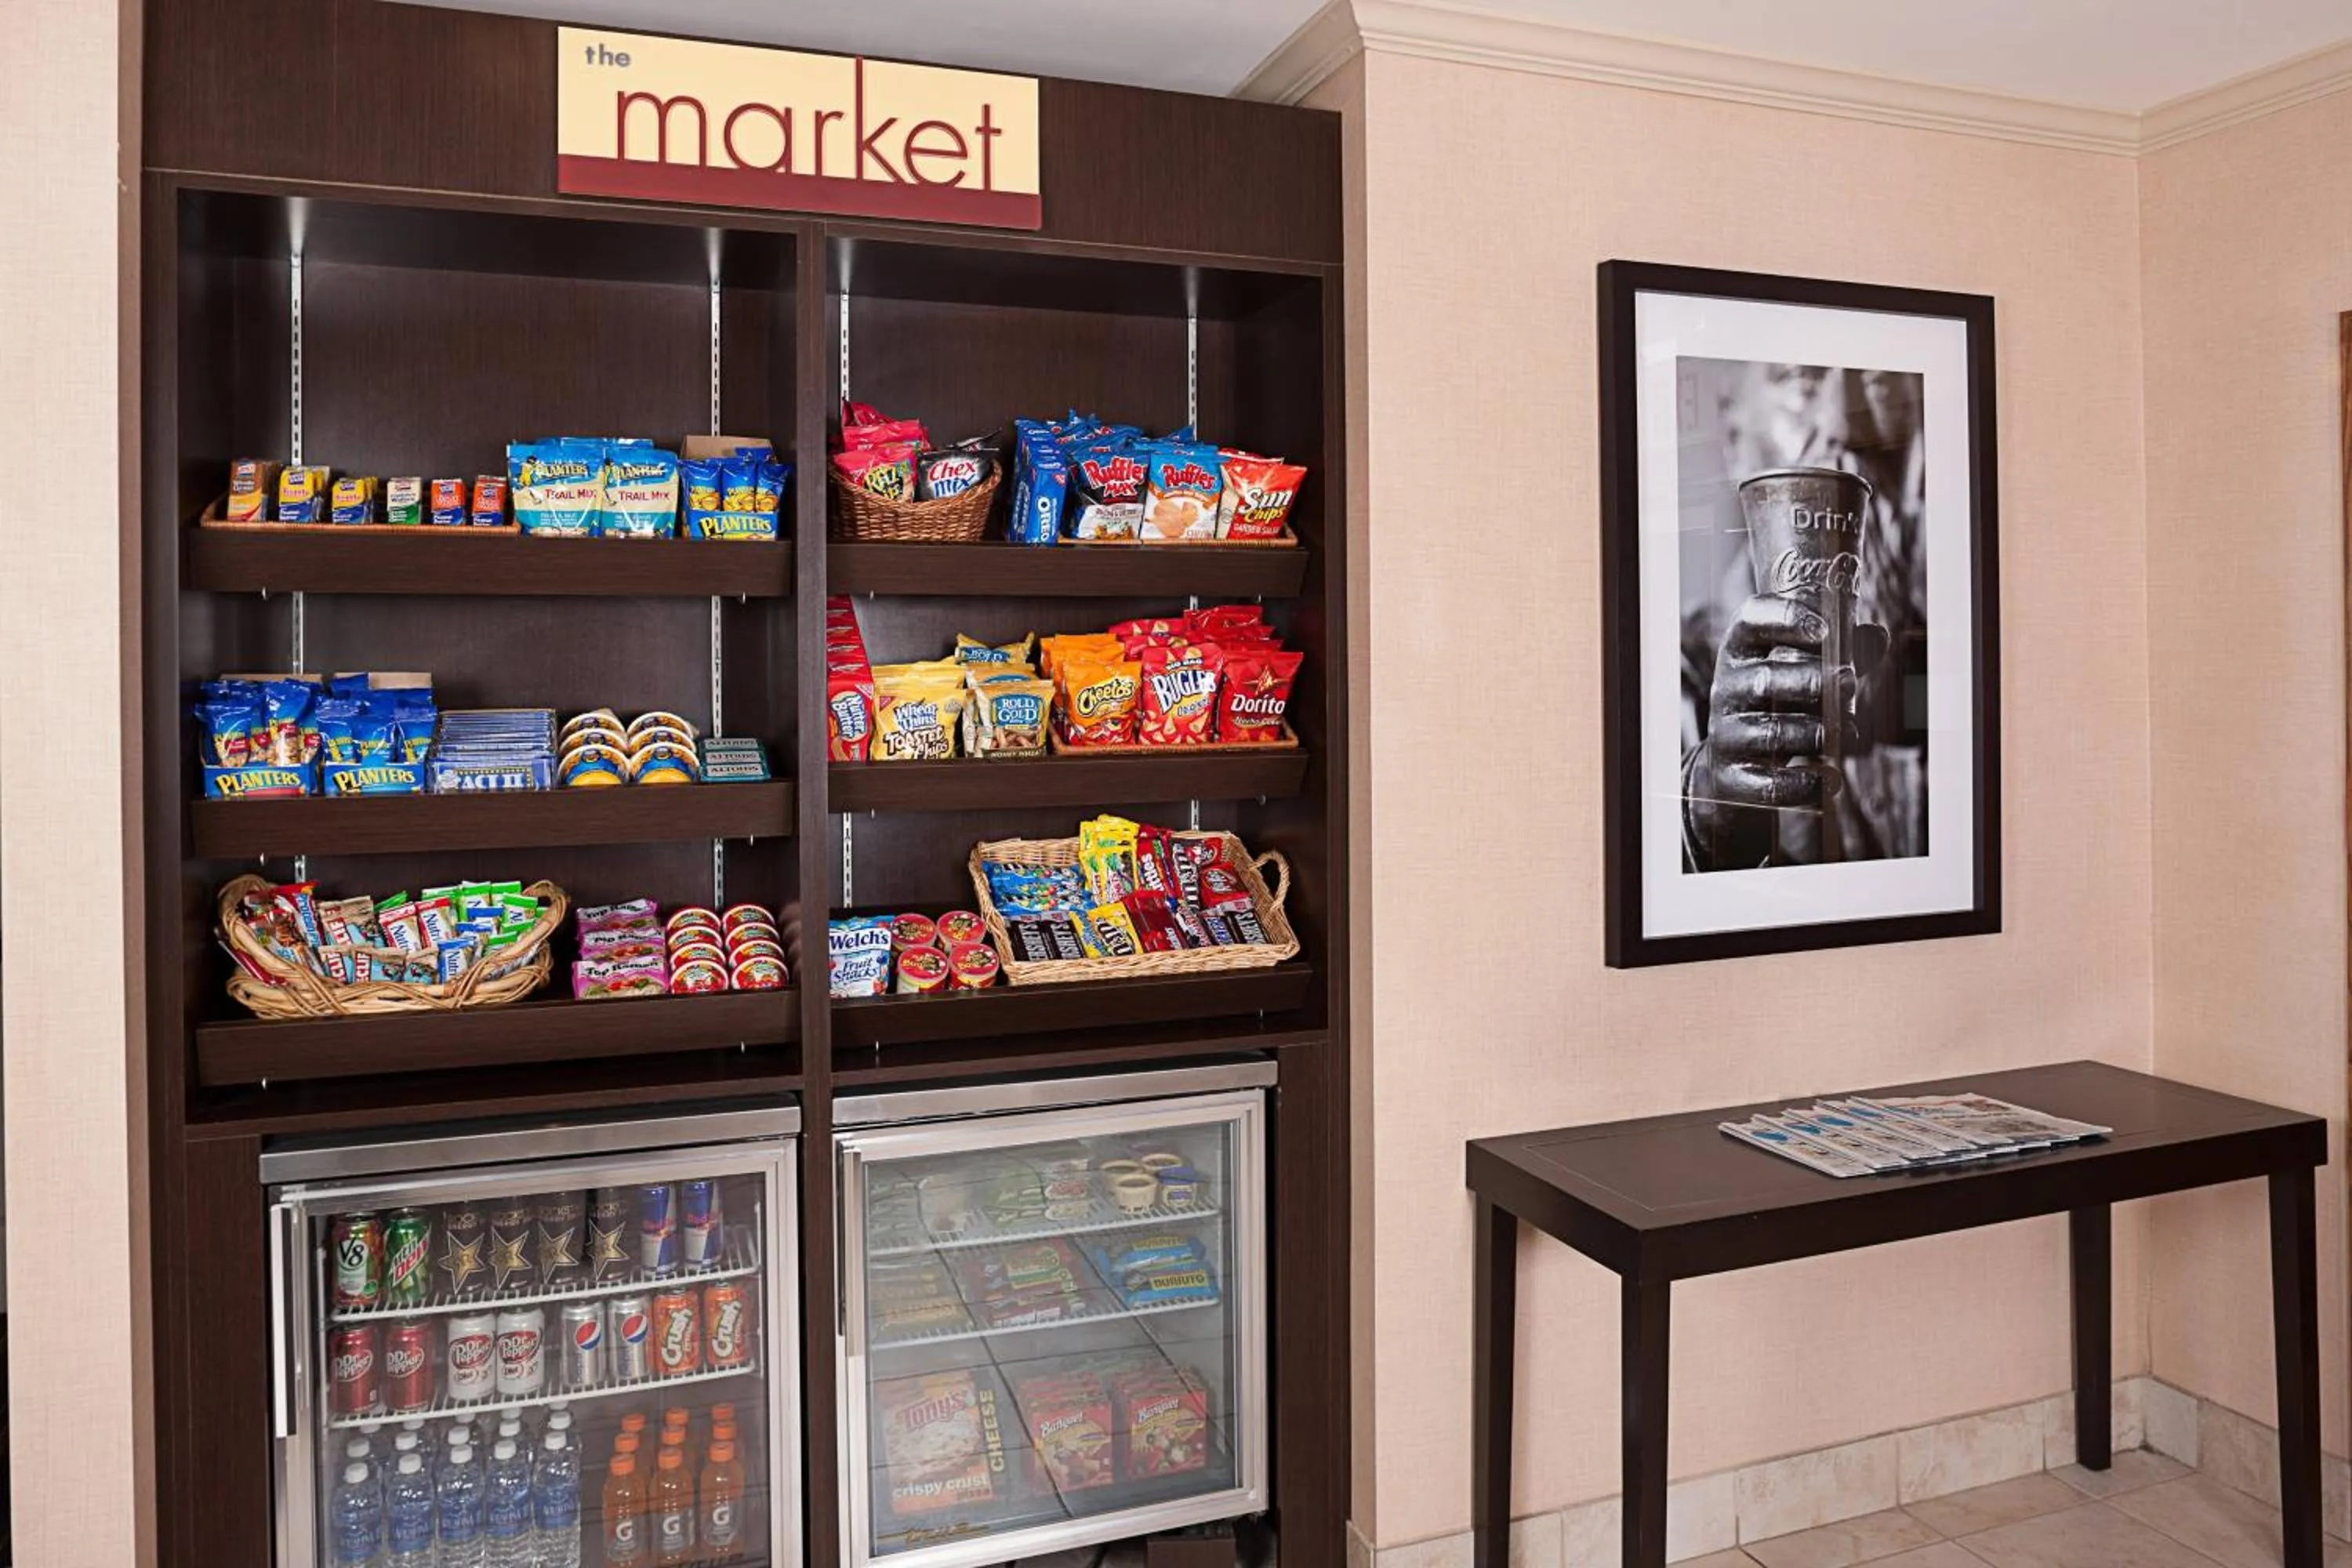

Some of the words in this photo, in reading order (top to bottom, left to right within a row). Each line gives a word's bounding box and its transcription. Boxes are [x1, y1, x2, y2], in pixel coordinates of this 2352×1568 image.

[585, 44, 631, 68] the
[617, 56, 1003, 191] market
[928, 461, 976, 481] Chex
[1082, 456, 1149, 489] Ruffle
[1162, 462, 1216, 490] Ruffles
[618, 491, 649, 501] TRAIL
[1102, 480, 1138, 497] MAX
[1240, 487, 1293, 514] Sun
[699, 514, 773, 537] PLANTERS
[1037, 496, 1051, 542] OREO
[1002, 698, 1035, 709] ROLD
[1076, 677, 1135, 718] Cheetos
[831, 701, 855, 739] Butter
[846, 694, 866, 733] Nutter
[895, 701, 938, 720] Wheat
[997, 708, 1037, 721] GOLD
[901, 714, 936, 731] Thins
[216, 771, 301, 797] PLANTERS
[333, 769, 416, 793] PLANTERS
[461, 774, 499, 789] ACT
[829, 931, 889, 951] Welch's
[1018, 924, 1049, 960] ERSHEY'S
[586, 966, 609, 976] Top
[842, 957, 873, 975] Fruit
[339, 1237, 365, 1267] V8
[979, 1390, 1004, 1472] CHEESE
[892, 1480, 944, 1498] crispy
[946, 1475, 988, 1490] crust
[662, 1515, 681, 1534] G
[712, 1505, 730, 1525] G
[615, 1520, 633, 1541] G
